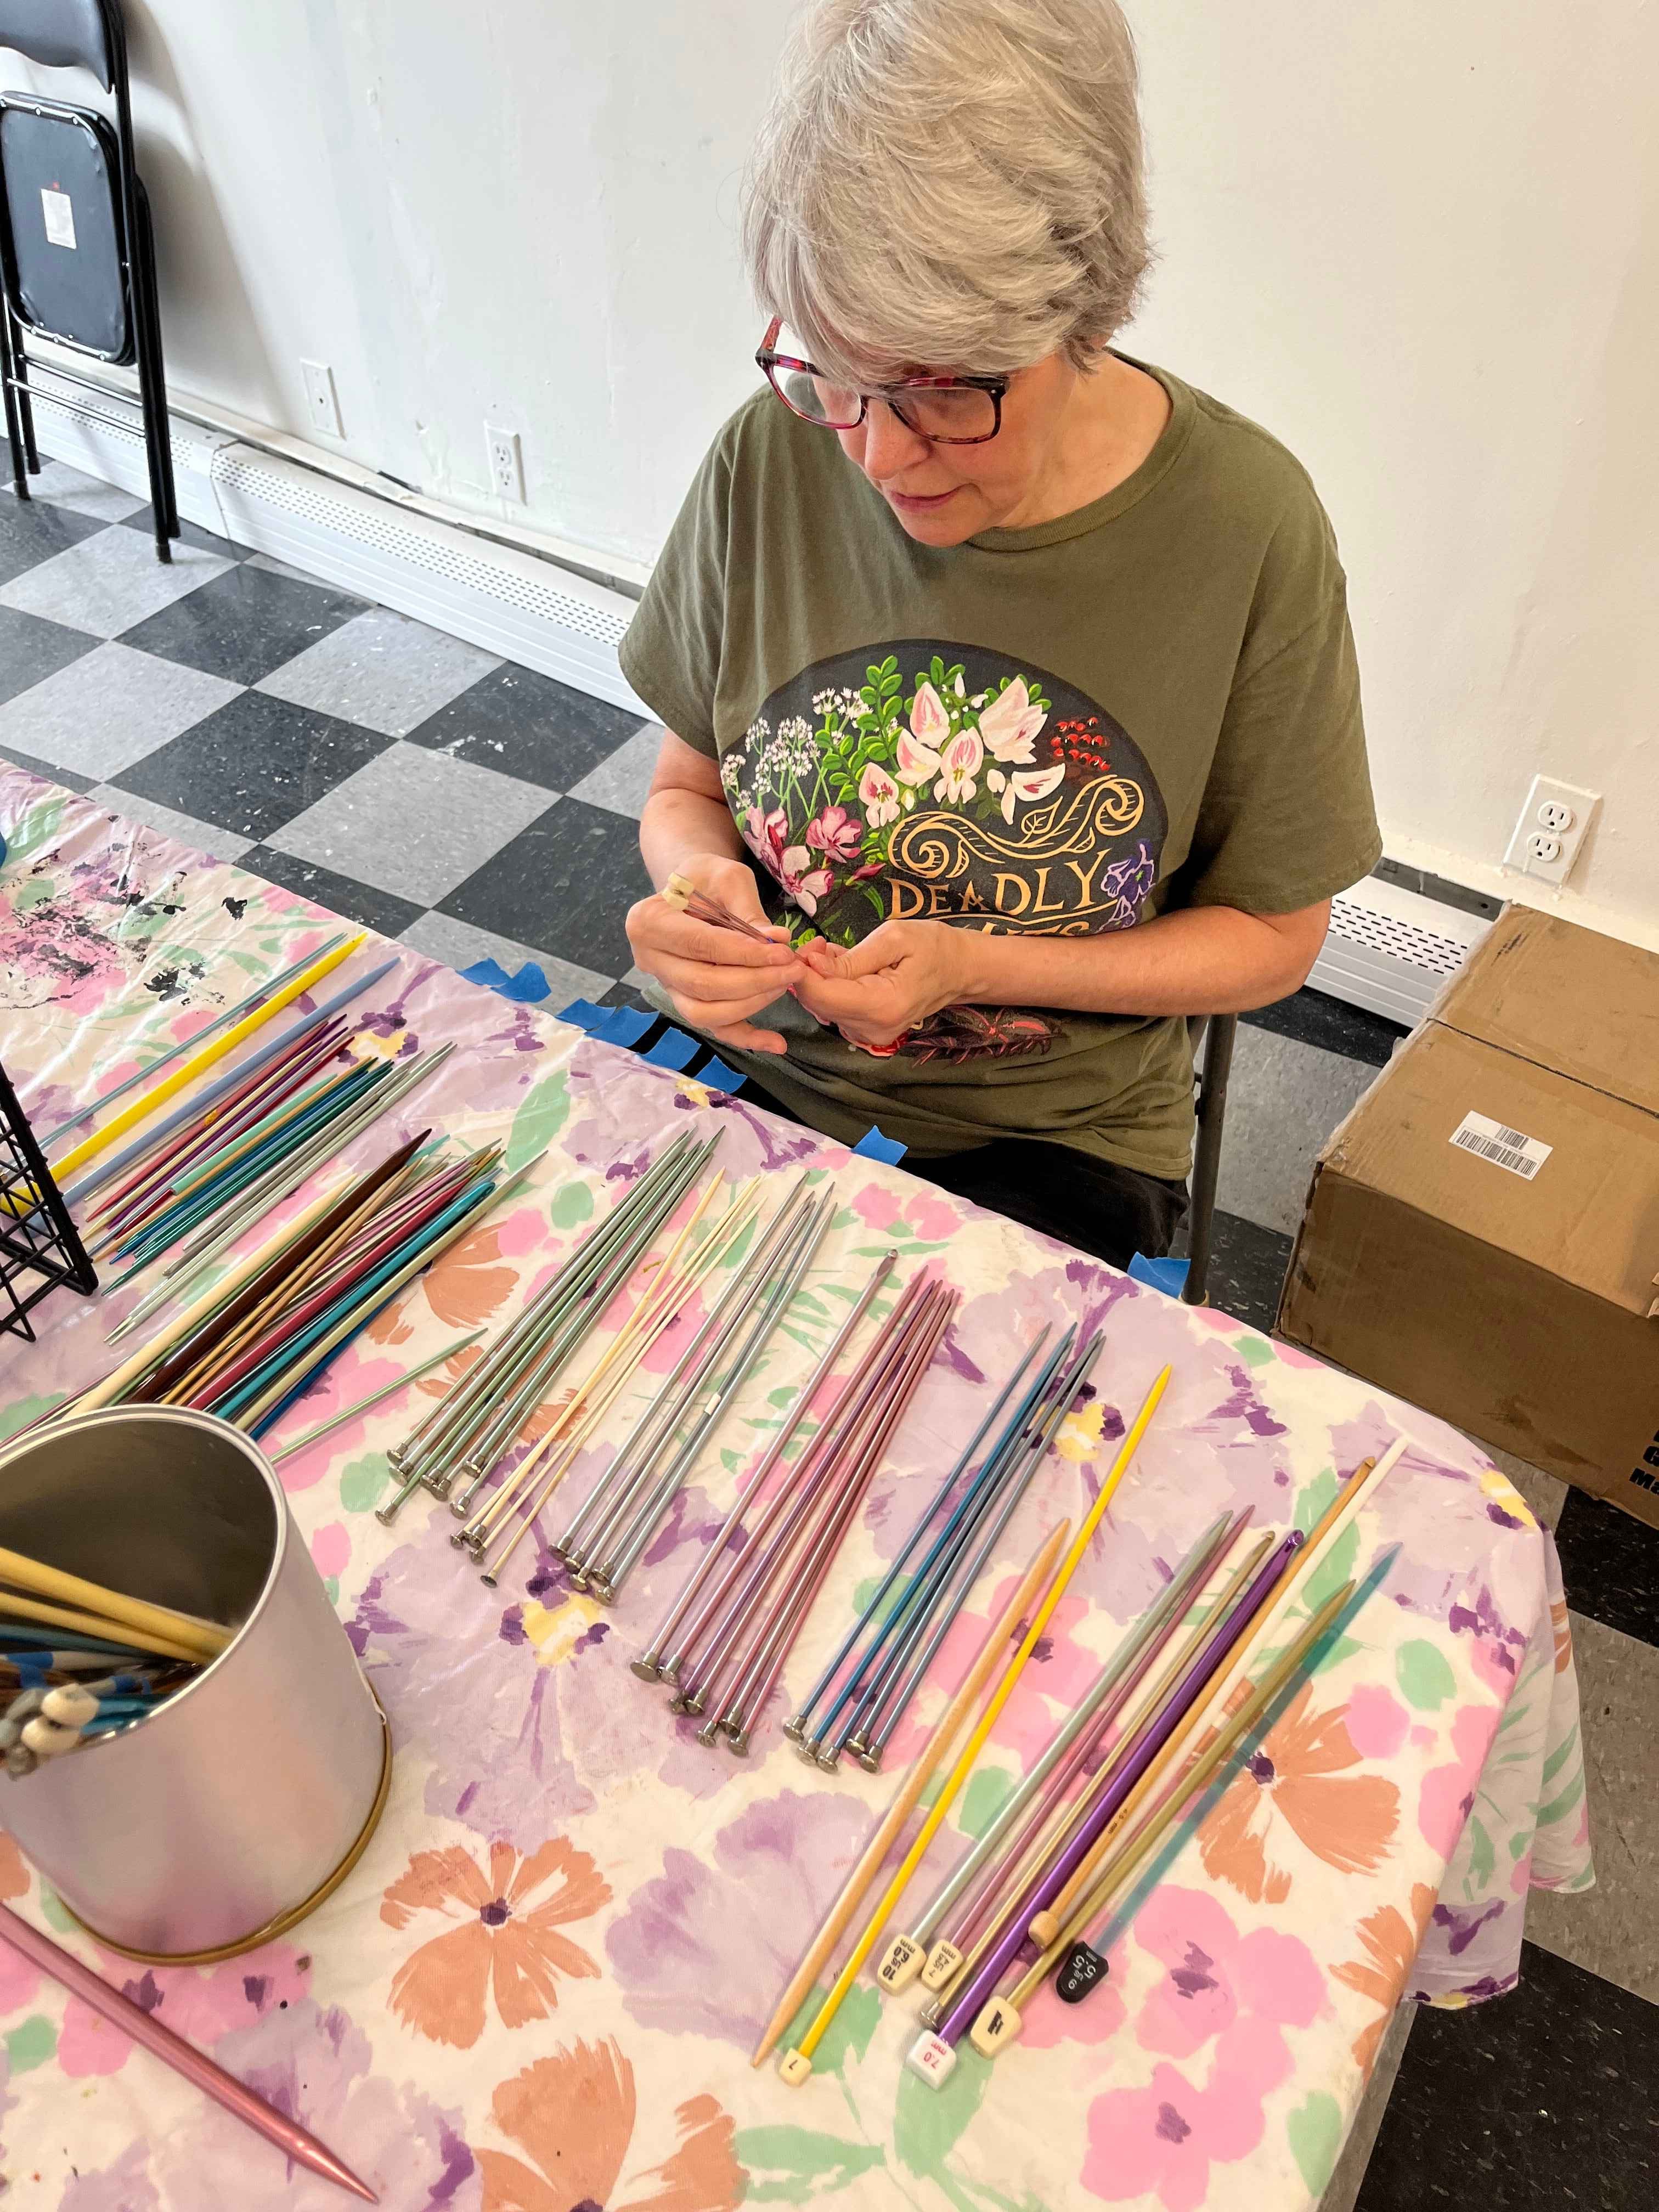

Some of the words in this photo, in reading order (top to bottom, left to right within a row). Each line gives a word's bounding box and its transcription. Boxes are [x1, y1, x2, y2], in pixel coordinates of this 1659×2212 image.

[884, 848, 1112, 919] DEADLY
[900, 1938, 916, 1954] mm
[941, 1945, 956, 1960] mm
[893, 1946, 910, 1963] 6.0
[891, 1957, 902, 1970] US
[1073, 1955, 1096, 1978] 5.5
[882, 1965, 896, 1980] 10
[1074, 1970, 1084, 1982] US
[1068, 1978, 1077, 1990] 9
[923, 2051, 940, 2069] 7.0
